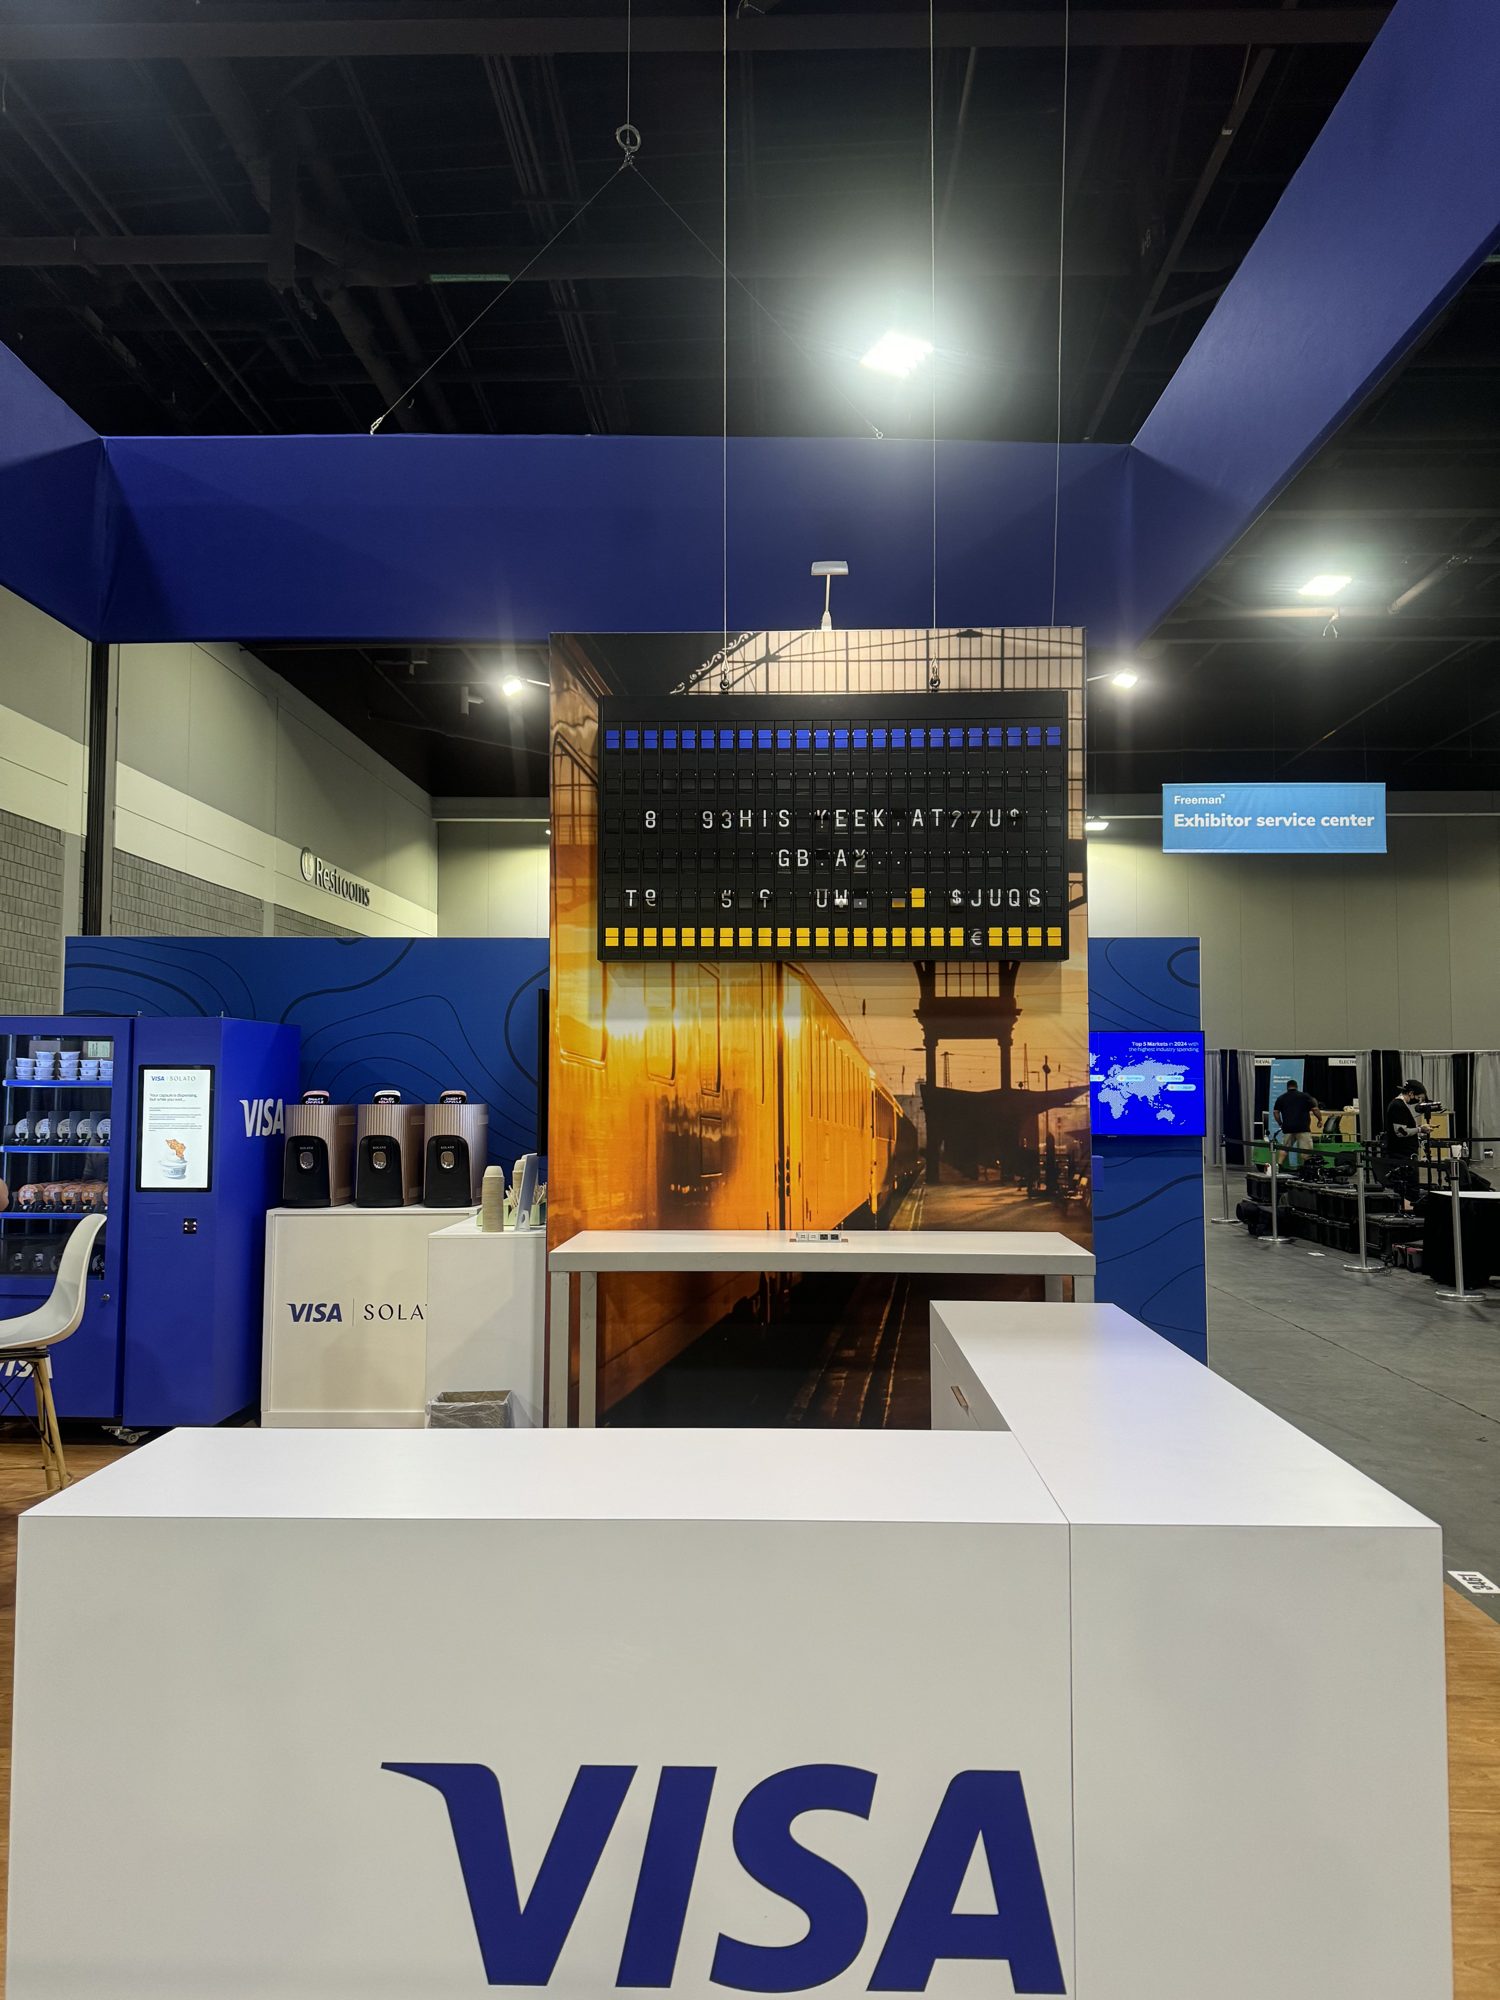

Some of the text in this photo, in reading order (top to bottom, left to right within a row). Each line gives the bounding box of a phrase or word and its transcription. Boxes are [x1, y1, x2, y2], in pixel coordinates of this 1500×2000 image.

[1174, 795, 1222, 805] Freeman
[1174, 813, 1375, 828] Exhibitor service center
[315, 857, 370, 907] Restrooms
[239, 1098, 285, 1138] VISA
[286, 1303, 343, 1323] VISA
[363, 1303, 428, 1321] SOLA
[381, 1762, 1067, 1995] VISA
